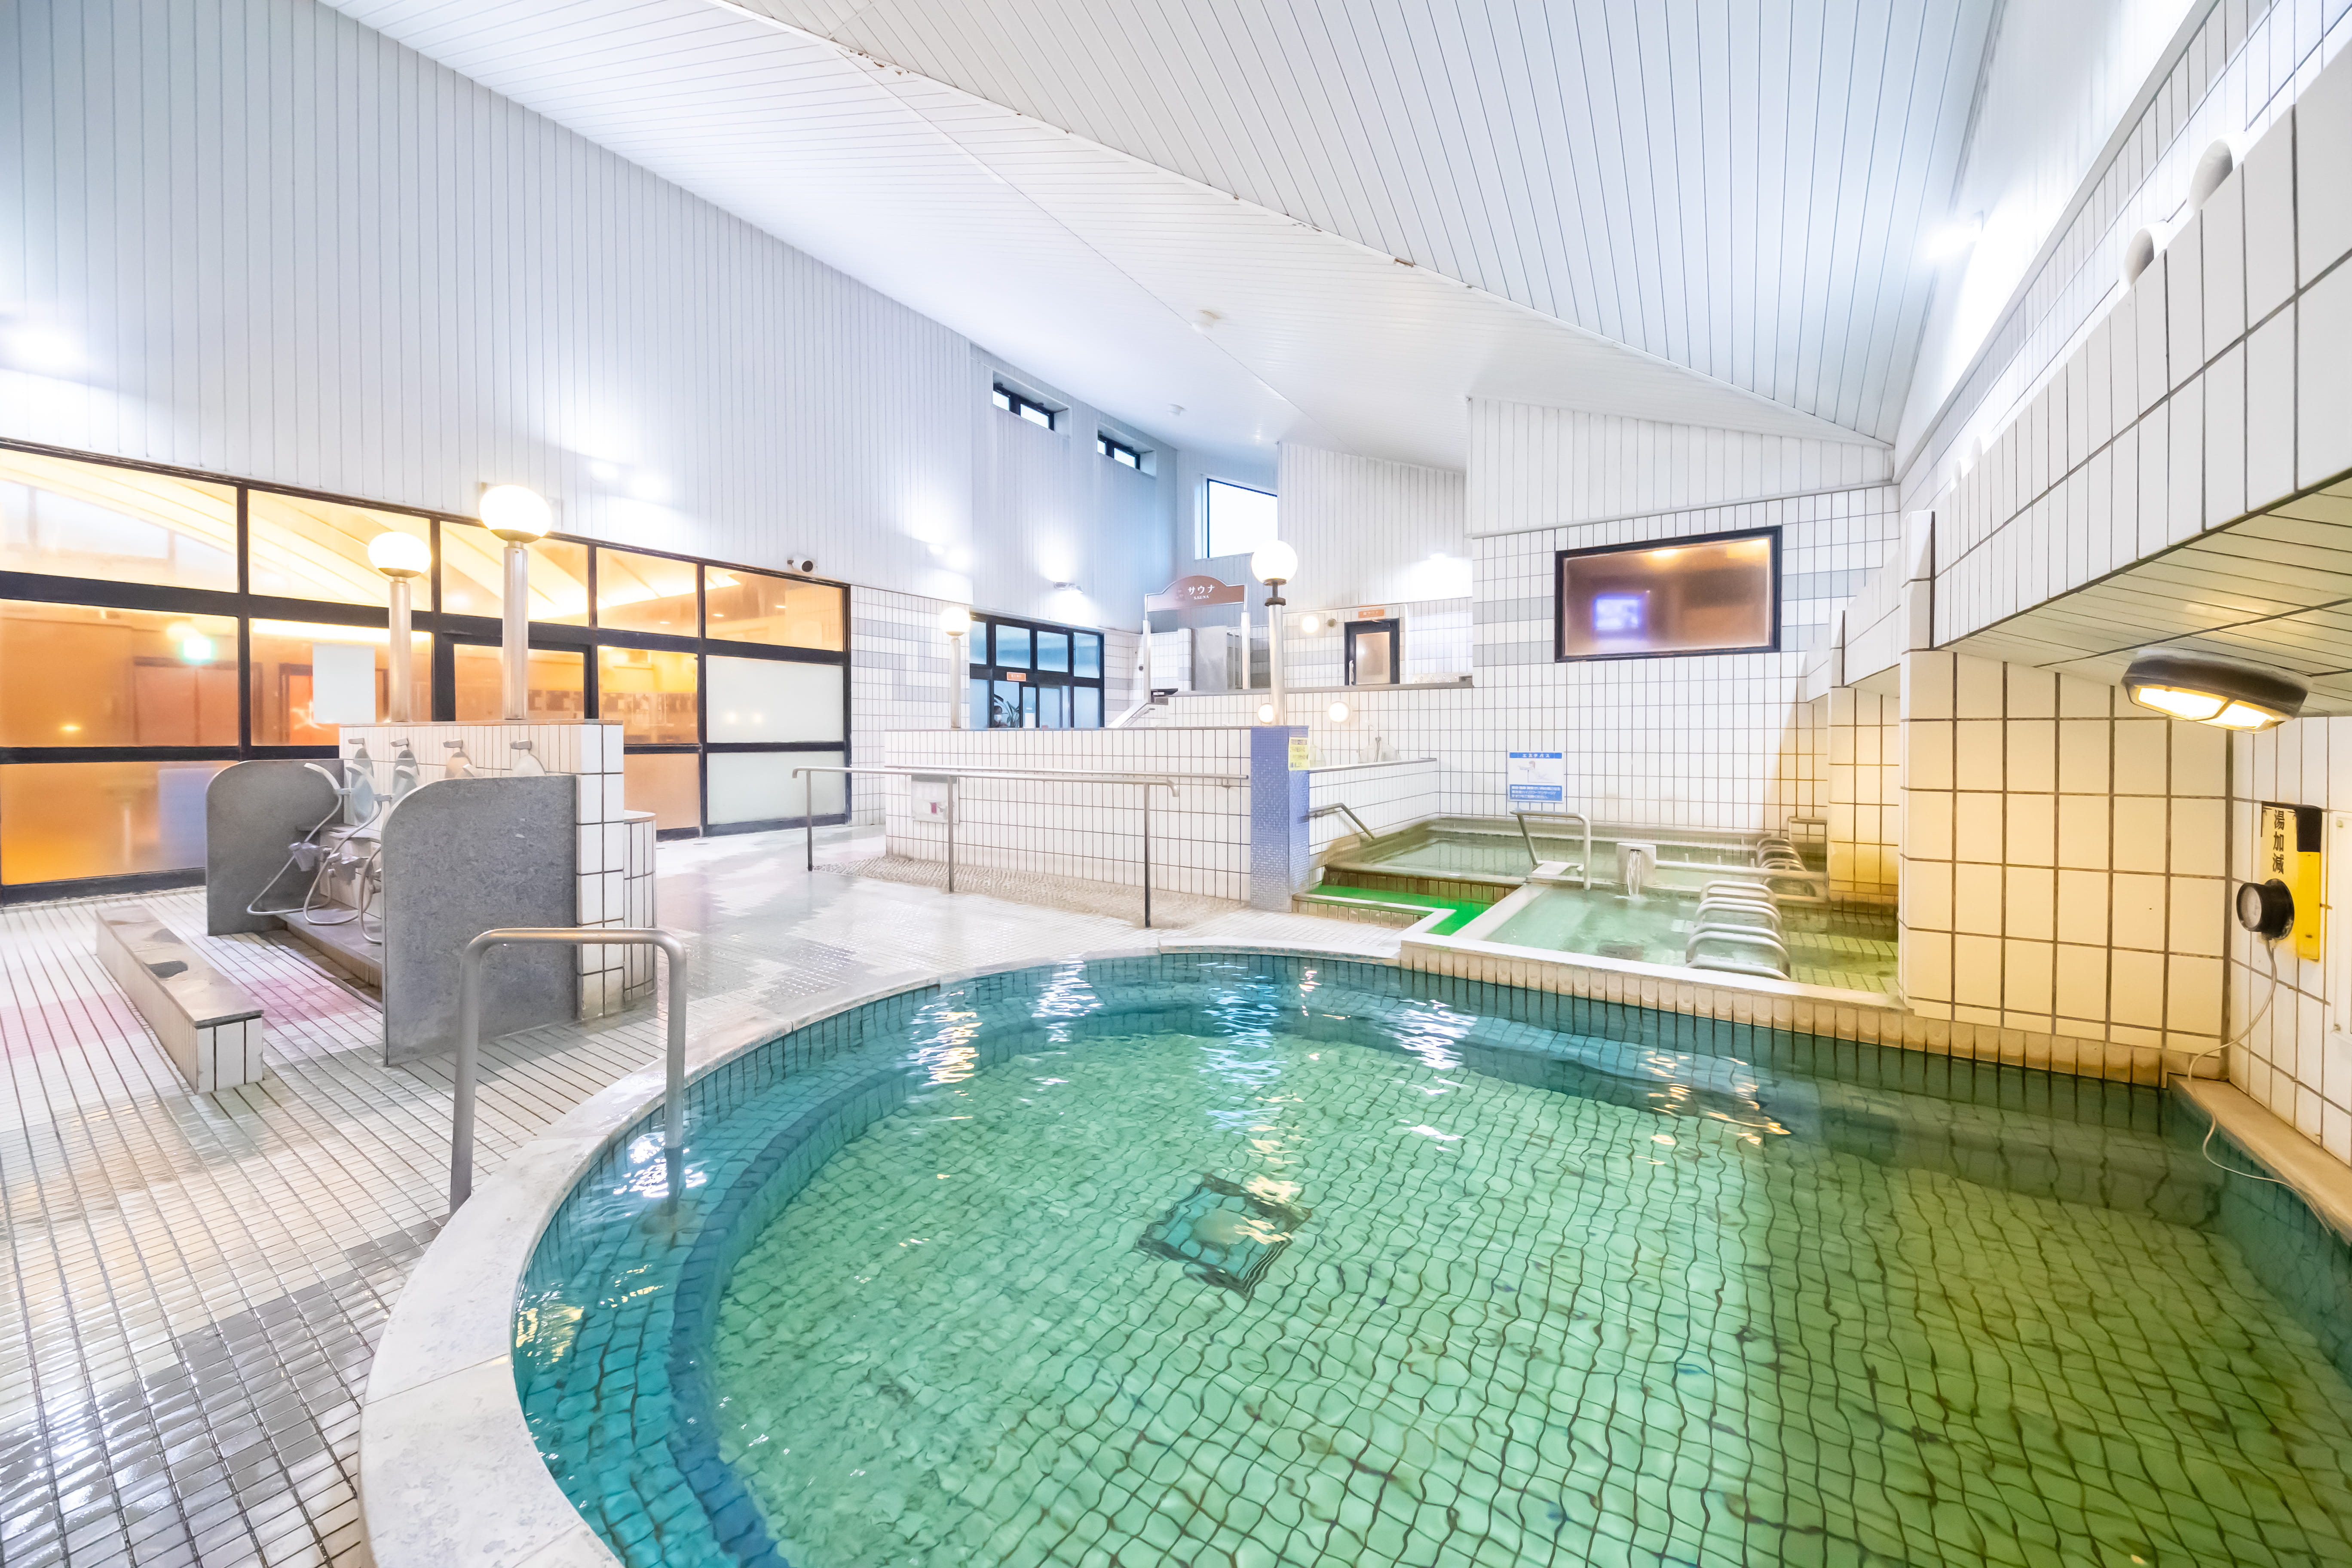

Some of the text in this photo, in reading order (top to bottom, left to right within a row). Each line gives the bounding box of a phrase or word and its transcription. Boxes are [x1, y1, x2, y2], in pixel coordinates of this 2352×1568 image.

[1188, 584, 1215, 595] サウナ
[2272, 809, 2285, 875] 湯加減
